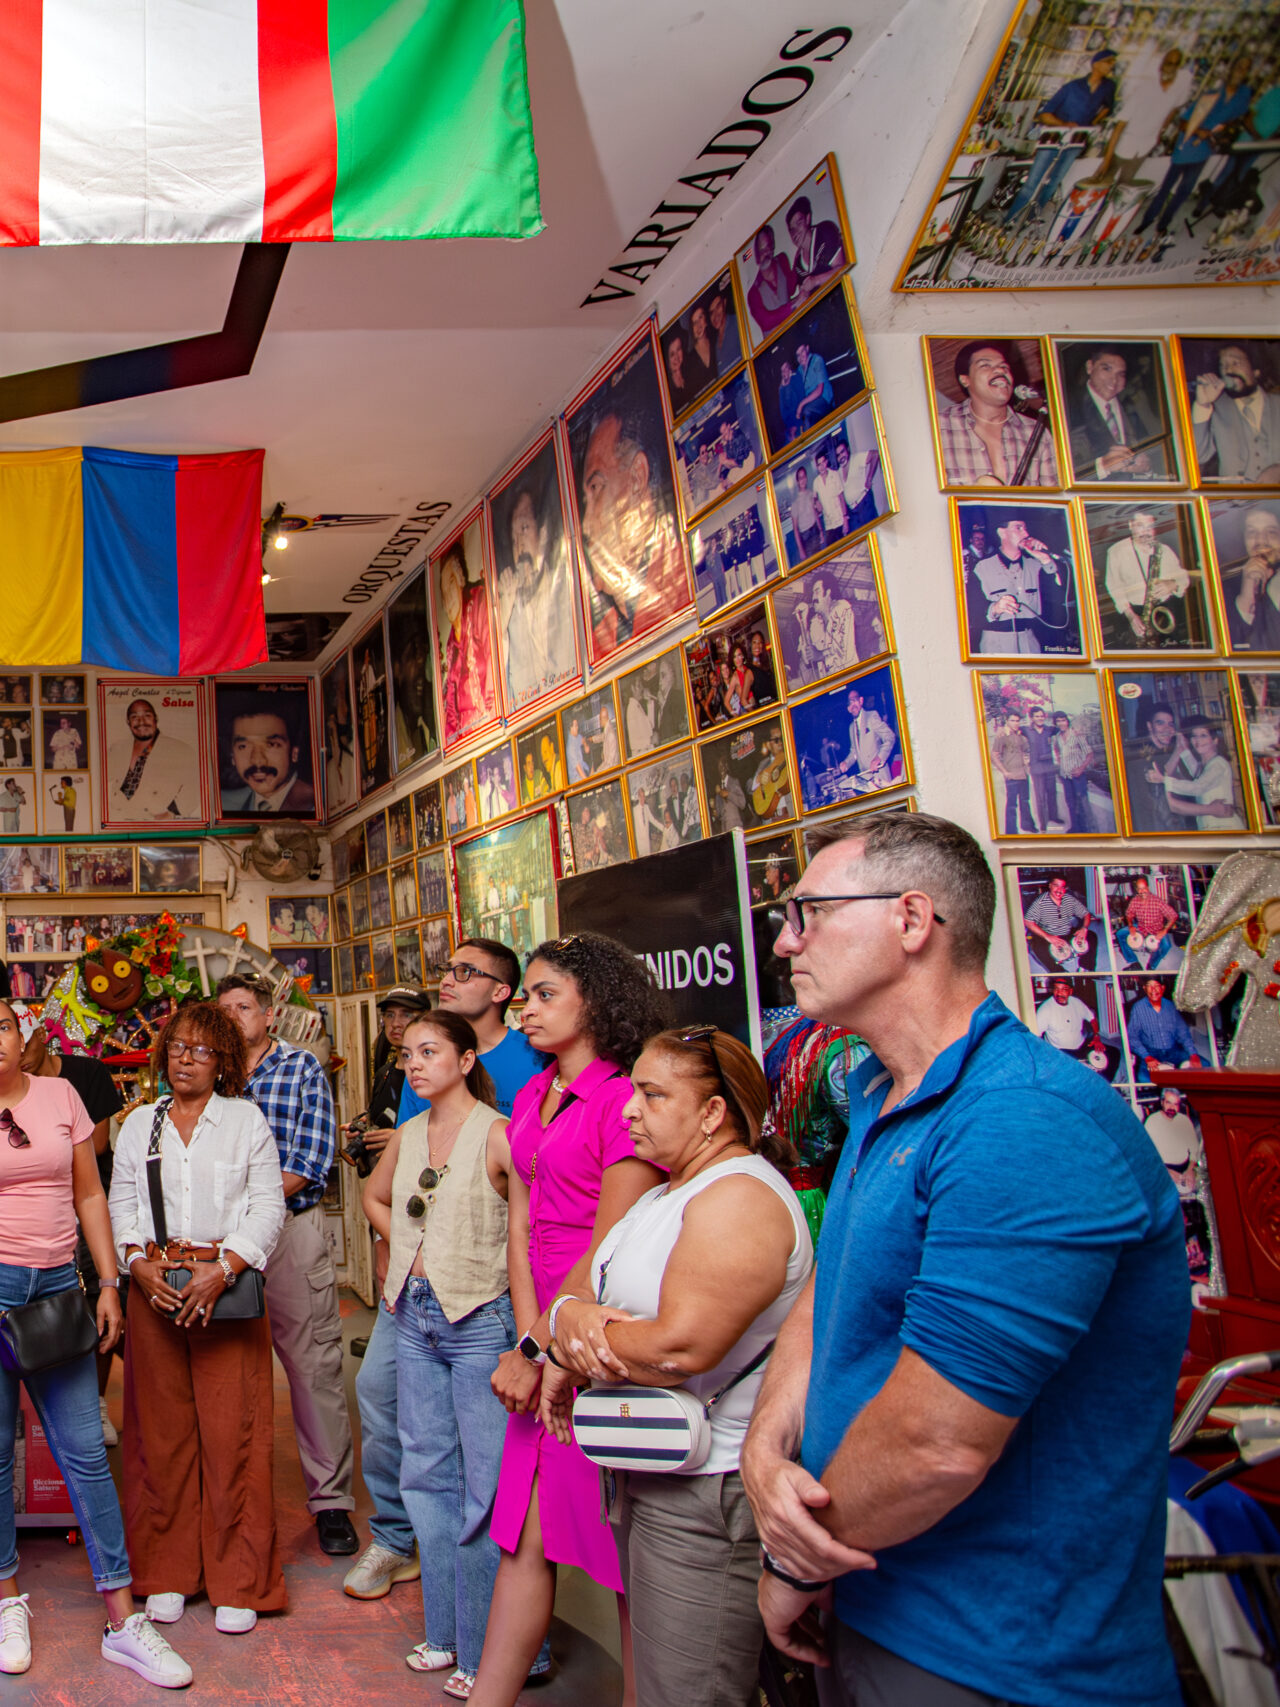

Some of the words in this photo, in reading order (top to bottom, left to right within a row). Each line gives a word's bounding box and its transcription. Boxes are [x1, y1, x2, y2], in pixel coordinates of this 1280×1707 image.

[579, 26, 853, 308] VARIADOS
[342, 501, 452, 603] ORQUESTAS
[107, 688, 129, 697] Angel
[132, 687, 160, 696] Canales
[162, 697, 195, 707] Salsa
[633, 943, 735, 991] NIDOS
